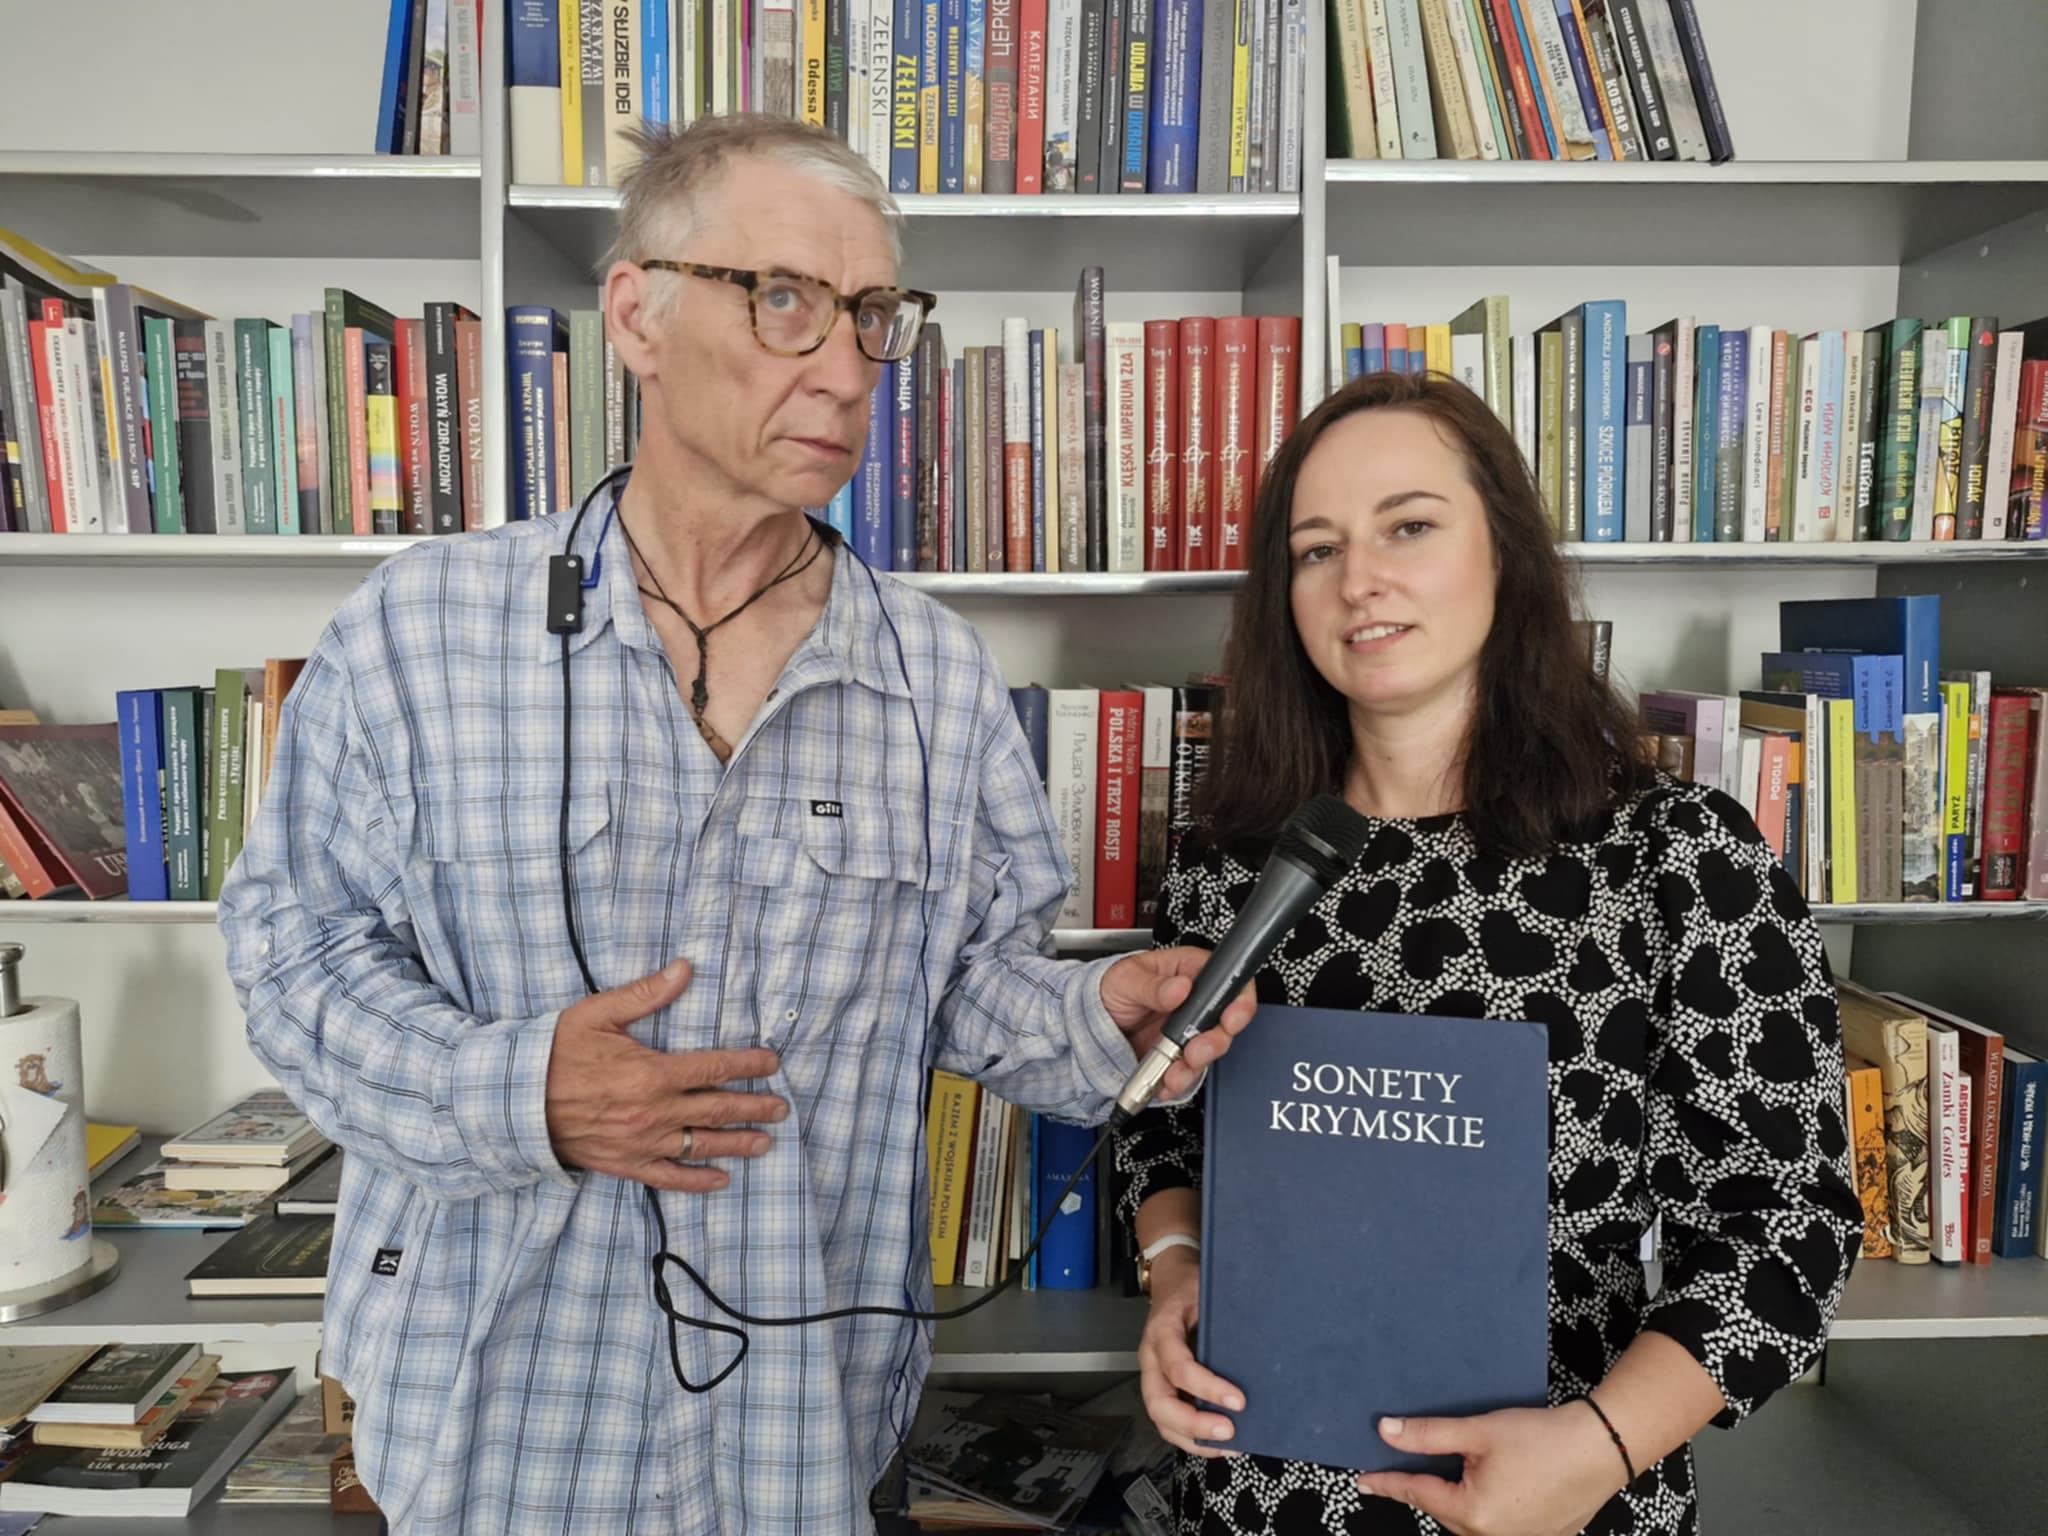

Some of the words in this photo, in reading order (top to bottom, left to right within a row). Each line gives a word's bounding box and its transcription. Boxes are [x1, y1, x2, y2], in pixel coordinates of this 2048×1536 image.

[871, 15, 889, 118] ZEŁENSKI
[925, 3, 938, 84] WOŁODYMYR
[592, 64, 603, 79] W
[808, 57, 821, 114] Odessa
[1027, 30, 1042, 120] КАПЕЛАНИ
[1128, 42, 1147, 93] WOJNA
[616, 82, 631, 115] IDEI
[895, 54, 917, 150] ZEŁENSKI
[925, 92, 938, 146] ZEŁENSKI
[990, 82, 1011, 161] МАЙДАН
[1128, 94, 1145, 110] W
[1605, 78, 1630, 133] КОБЗАР
[1126, 111, 1143, 174] UKRAINIE
[1602, 312, 1612, 358] ANDRZEJ
[1720, 341, 1733, 369] ЙОВА
[1119, 351, 1134, 376] ZŁA
[1272, 363, 1286, 409] POLSKI
[1720, 371, 1733, 393] ДЛЯ
[435, 373, 452, 418] WOŁYŃ
[1119, 378, 1135, 440] IMPERIUM
[1153, 366, 1166, 412] POLSKI
[1602, 360, 1612, 420] BOBKOWSKI
[1804, 388, 1813, 413] ECO
[409, 402, 423, 445] WOŁYŃ
[1720, 395, 1733, 449] ПОЗИВНИЙ
[1754, 402, 1765, 423] Lew
[411, 447, 419, 462] we
[436, 419, 452, 496] ZDRADZONY
[898, 417, 911, 469] НАРИС
[1119, 442, 1137, 488] KLĘSKA
[1599, 425, 1615, 463] SZKICE
[1751, 431, 1766, 489] komedianci
[131, 467, 141, 489] SDP
[411, 464, 422, 488] krwi
[1597, 465, 1617, 516] PIÓRKIEM
[1818, 439, 1834, 497] КОРДОНИ
[411, 490, 423, 516] 1943
[1108, 707, 1124, 755] POLSKA
[1124, 707, 1139, 742] Andrzej
[1070, 730, 1088, 779] Лицарі
[1108, 758, 1121, 766] I
[1125, 744, 1138, 776] Nowak
[1175, 743, 1193, 756] O
[1967, 753, 1980, 789] Ekwador
[1106, 768, 1122, 816] TRZY
[1770, 754, 1785, 802] PODOLE
[816, 802, 841, 815] Gill
[1070, 783, 1088, 845] Зимових
[1103, 818, 1121, 862] ROSJE
[1291, 1061, 1463, 1104] SONETY
[1942, 1070, 1957, 1120] Zamki
[1987, 1051, 2001, 1097] WŁADZA
[949, 1092, 962, 1129] RAZEM
[1269, 1100, 1486, 1149] KRYMSKIE
[1959, 1083, 1970, 1142] ABSURDY
[1983, 1100, 1998, 1150] LOKALNA
[942, 1140, 957, 1192] WOJSKIEM
[1942, 1126, 1955, 1180] Castles
[1983, 1153, 1993, 1161] A
[1981, 1164, 1993, 1198] MEDIA
[937, 1194, 951, 1240] POLSKIM
[100, 1447, 153, 1460] WODA
[124, 1460, 173, 1471] KARPAT
